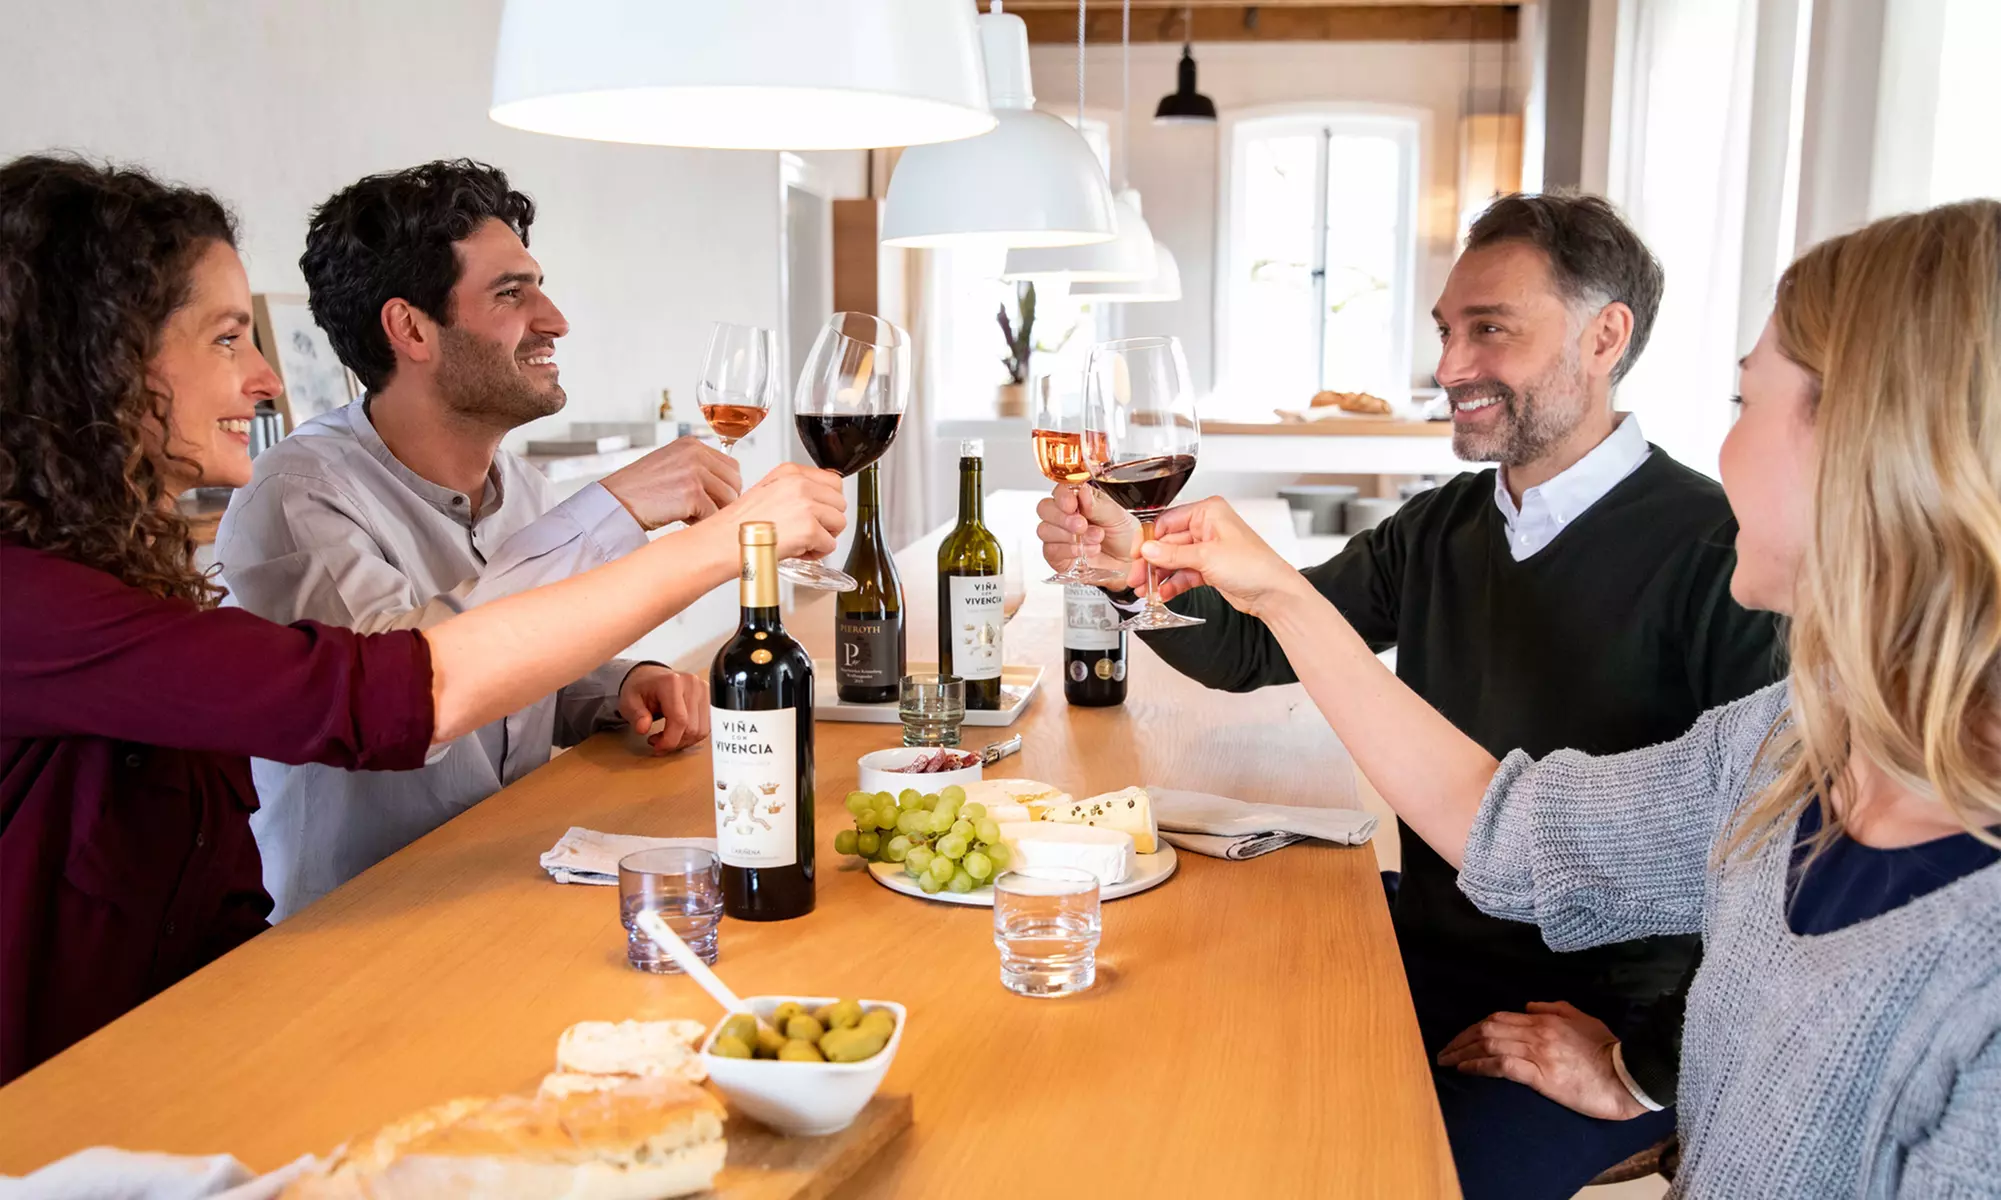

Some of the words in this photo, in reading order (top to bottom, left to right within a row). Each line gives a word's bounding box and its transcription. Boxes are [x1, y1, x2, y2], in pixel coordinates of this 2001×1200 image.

[974, 582, 997, 591] VIÑA
[840, 624, 881, 634] PIEROTH
[722, 720, 758, 734] VIÑA
[716, 740, 773, 755] VIVENCIA
